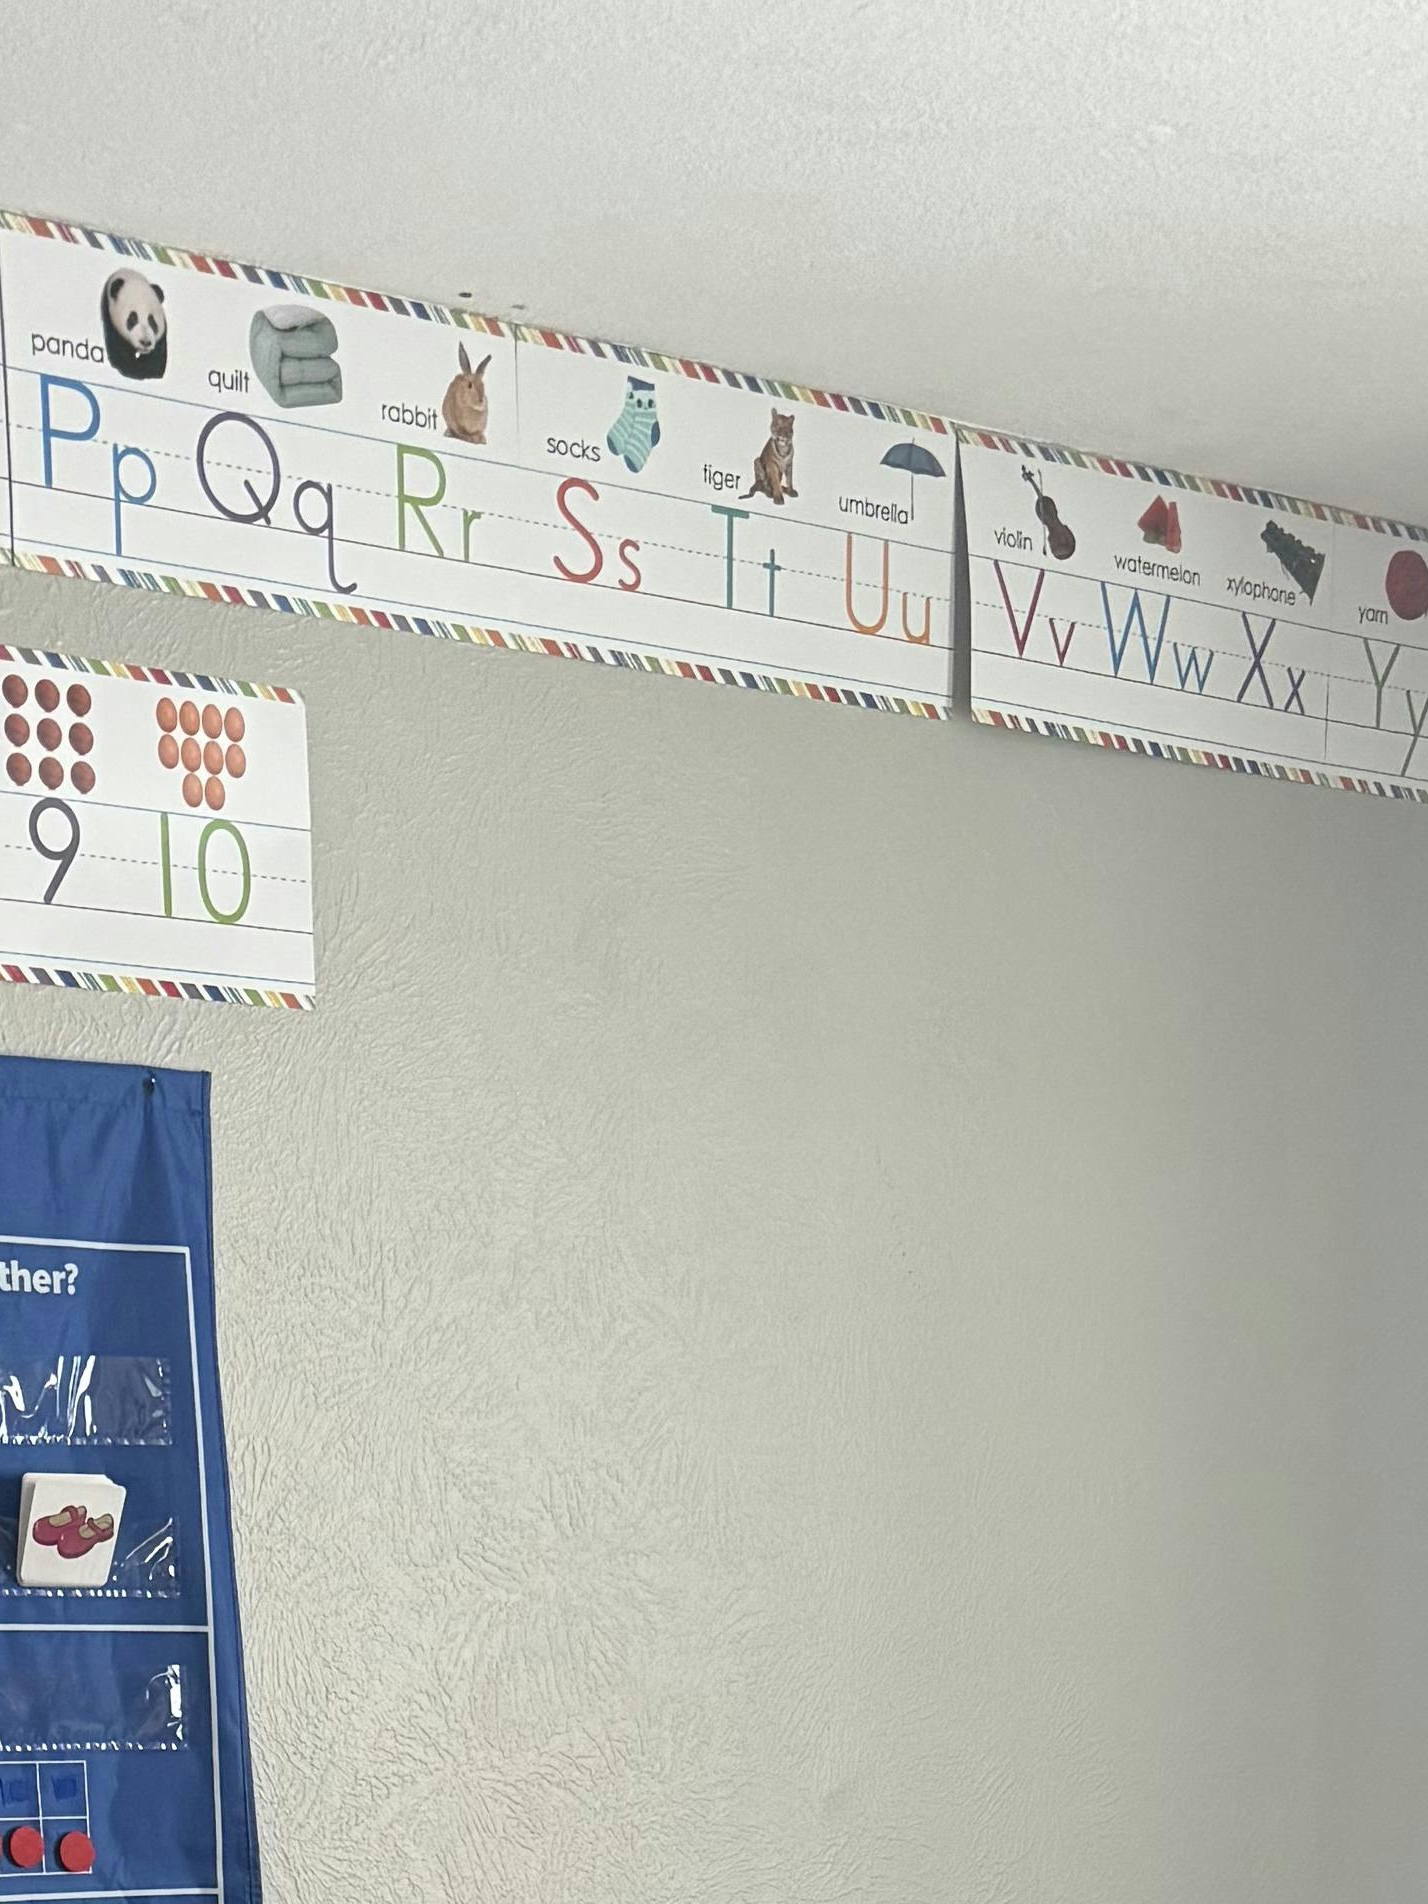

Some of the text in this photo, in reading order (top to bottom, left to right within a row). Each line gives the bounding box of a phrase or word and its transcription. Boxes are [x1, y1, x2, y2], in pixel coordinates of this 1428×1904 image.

[30, 330, 439, 430] panda quilt rabbit
[38, 372, 482, 595] Pp Qq Rr
[546, 434, 910, 525] socks tiger umbrella
[552, 476, 932, 646] Ss Tt Uu
[993, 526, 1034, 553] violin
[1113, 552, 1202, 588] watermelon
[1225, 575, 1297, 607] xylophone
[1357, 604, 1390, 627] yarn
[992, 559, 1076, 668] Vv
[1100, 580, 1214, 695] Ww
[1236, 611, 1307, 717] Xx
[27, 797, 81, 906] 9
[159, 810, 252, 926] 10
